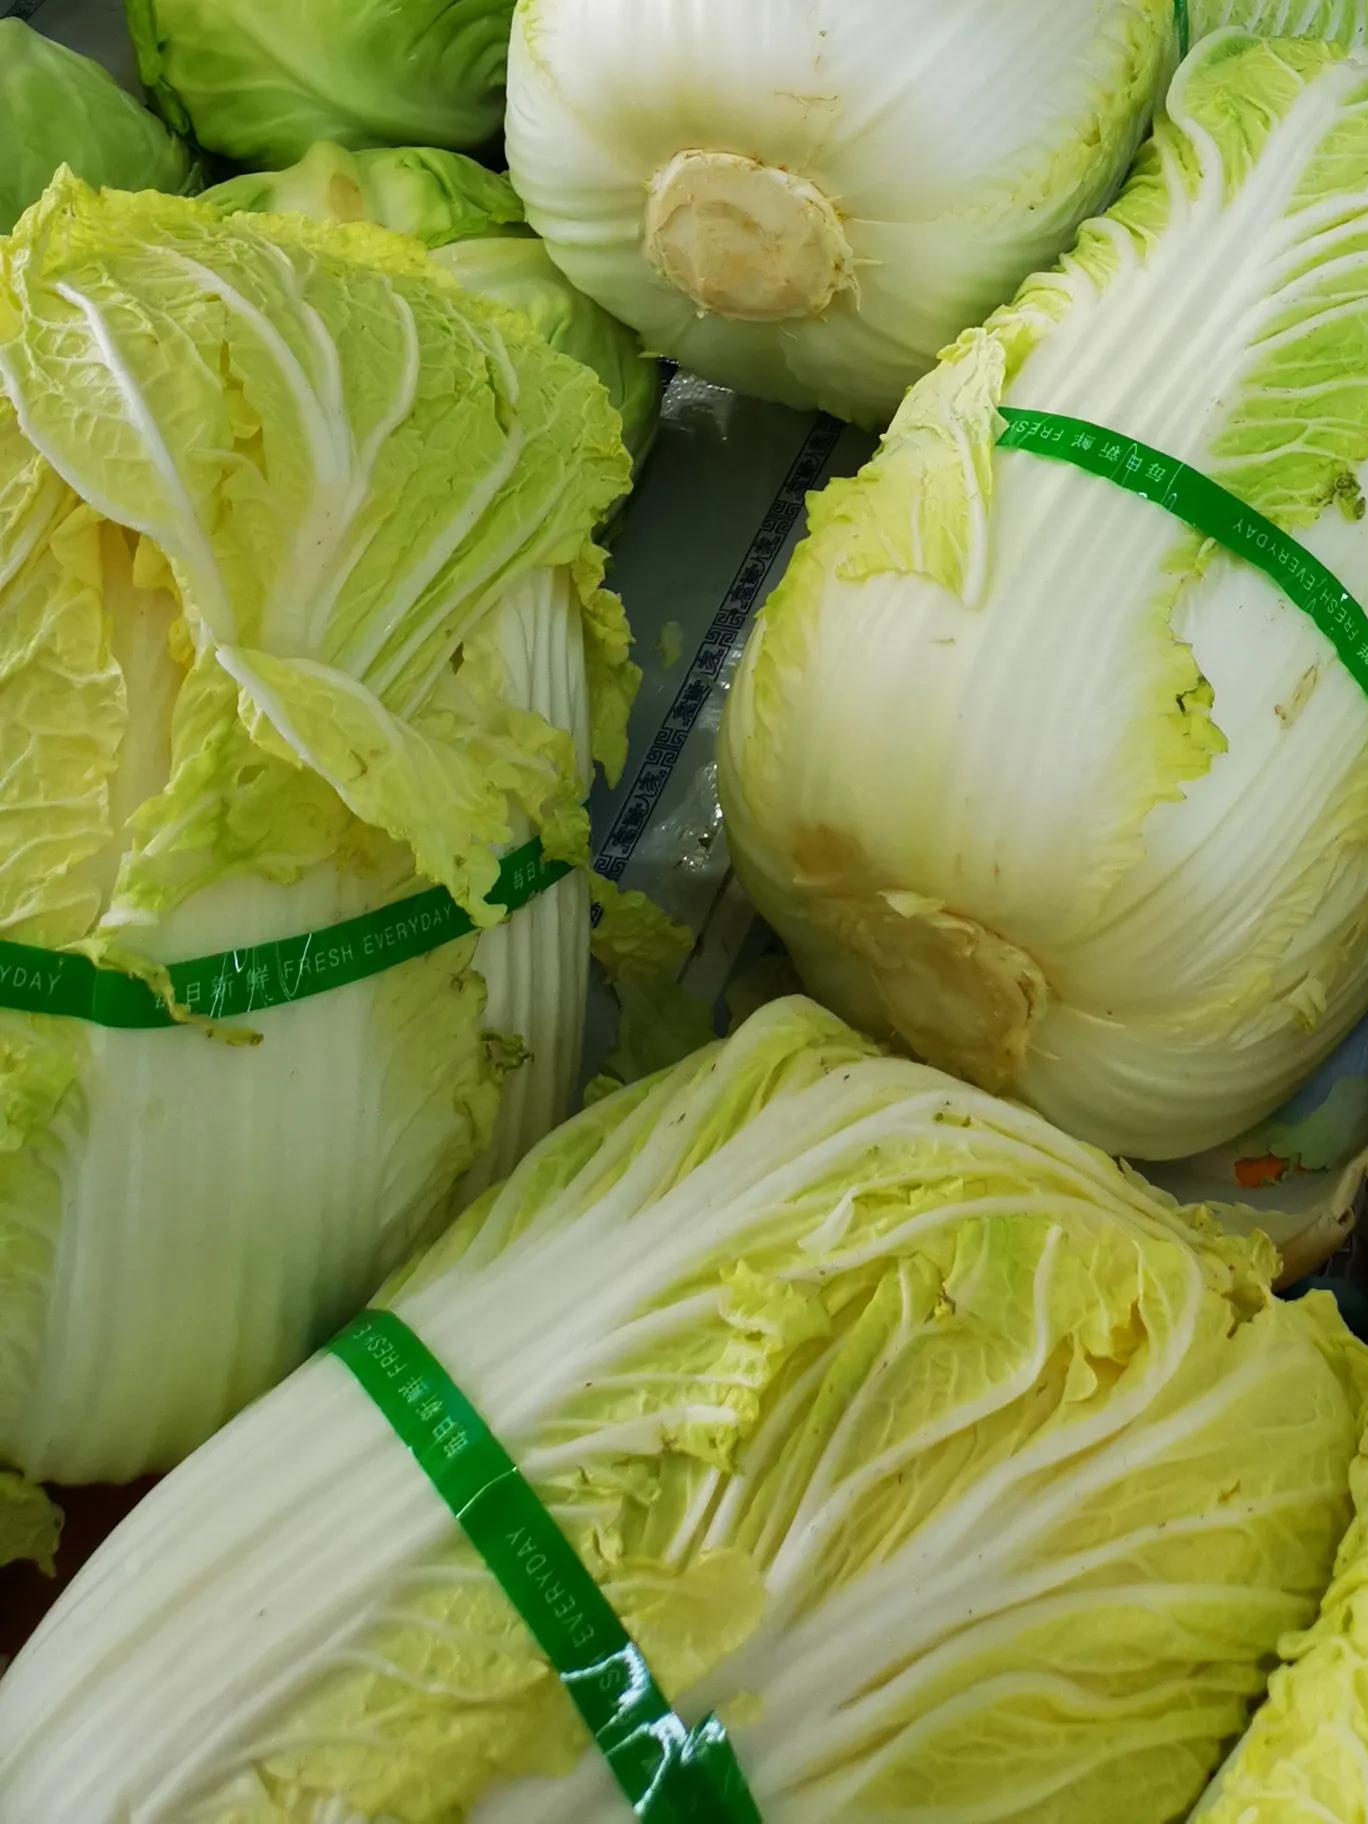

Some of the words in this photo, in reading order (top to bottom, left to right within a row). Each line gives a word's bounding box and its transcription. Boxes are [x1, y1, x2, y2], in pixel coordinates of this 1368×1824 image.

[1232, 517, 1317, 592] EVERYDAY
[1319, 587, 1360, 642] FRESH
[283, 946, 355, 980] FRESH
[362, 903, 452, 955] EVERYDAY
[505, 1526, 596, 1649] EVERYDAY
